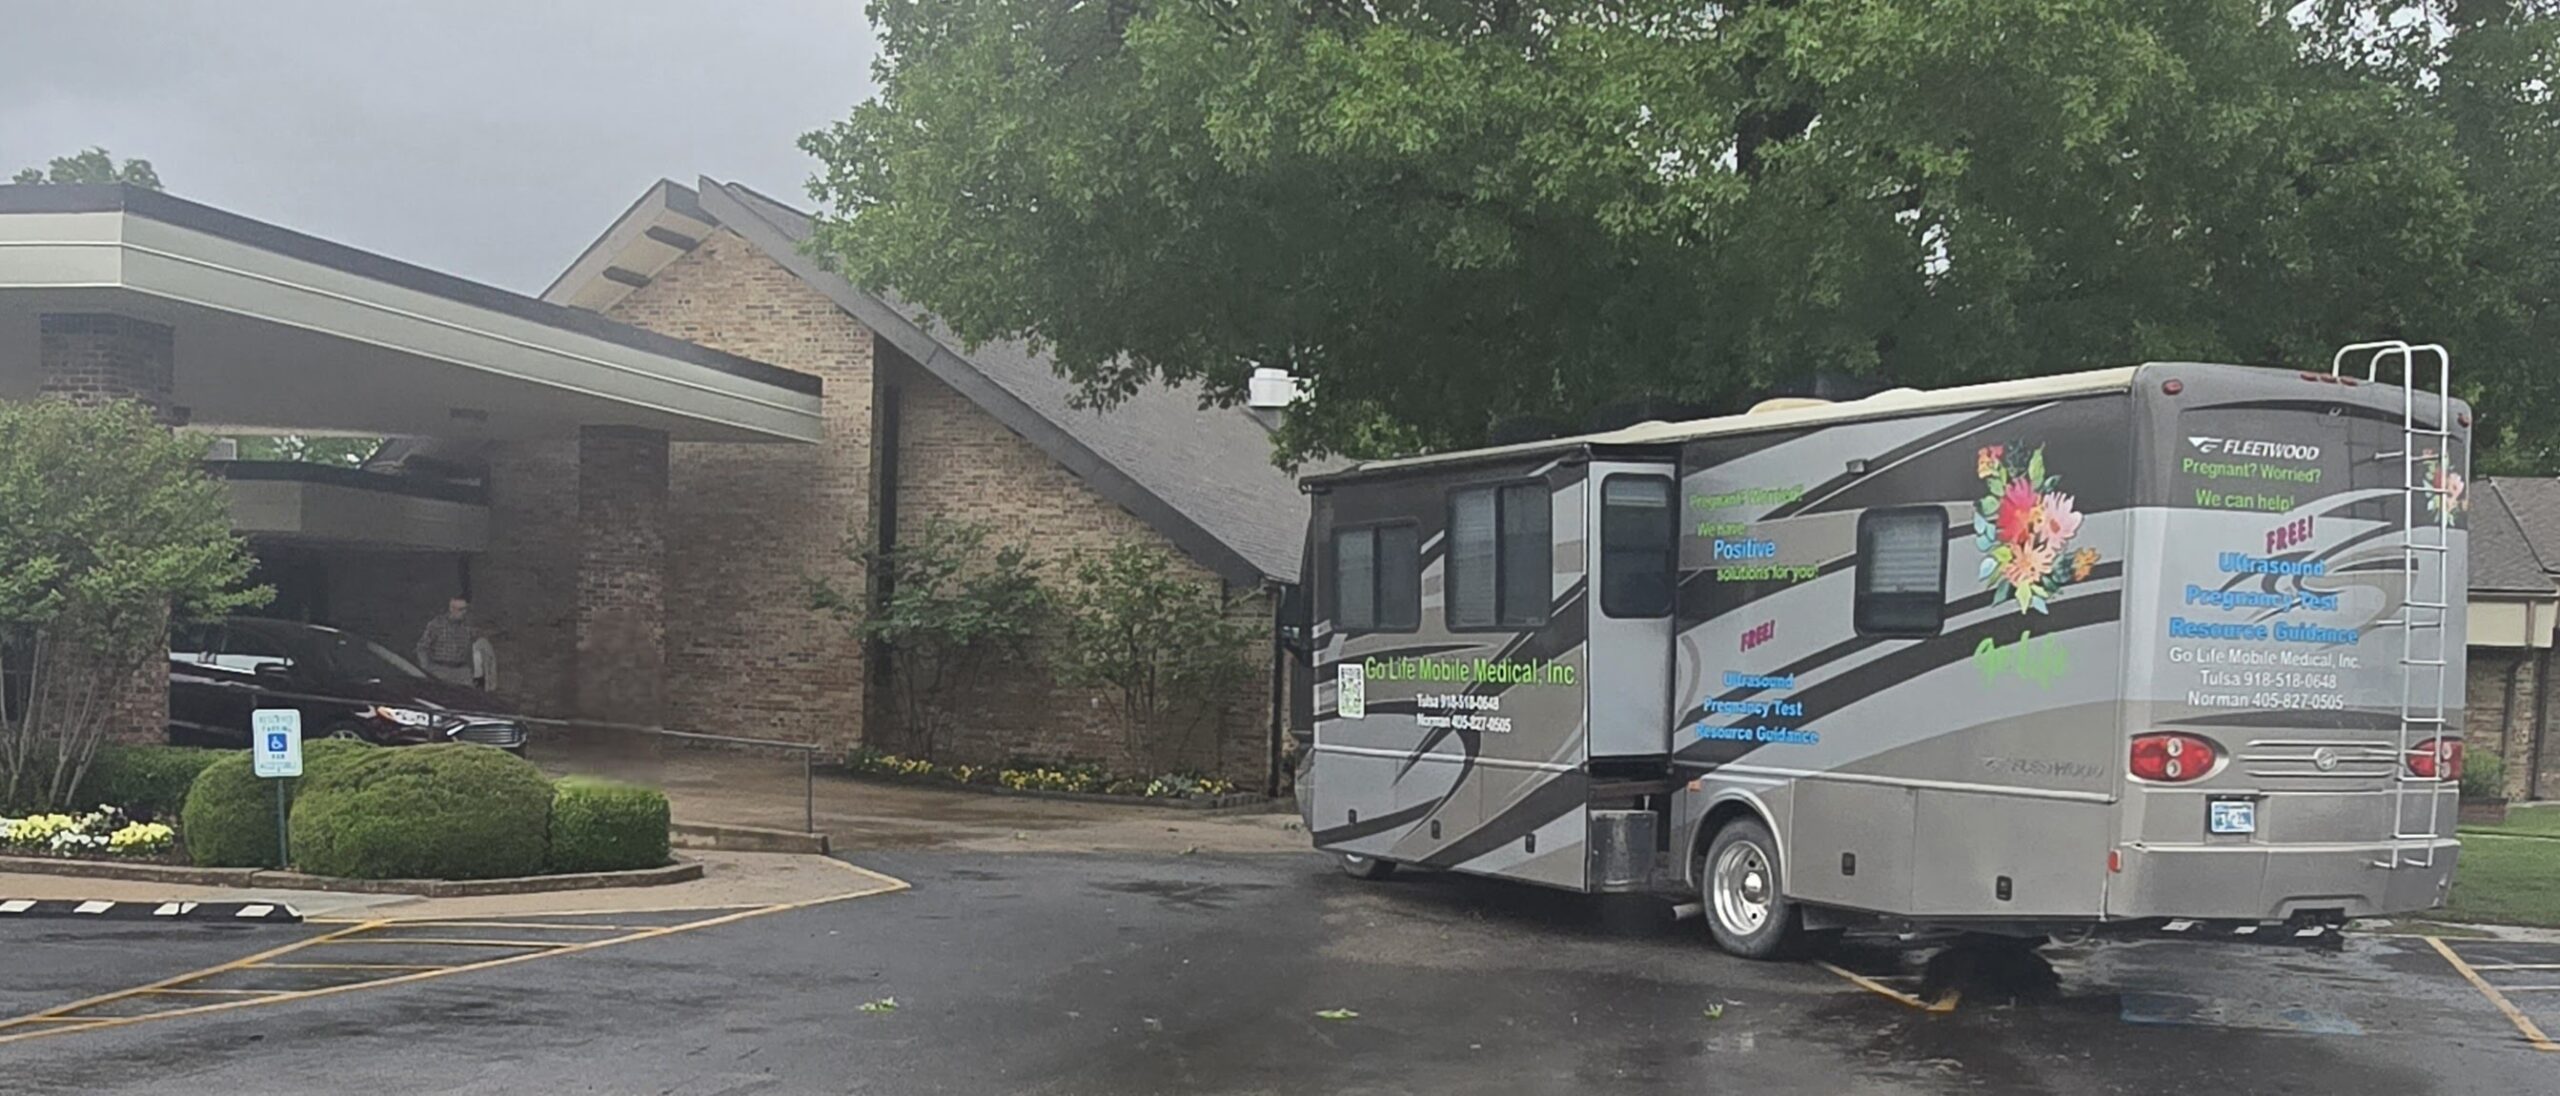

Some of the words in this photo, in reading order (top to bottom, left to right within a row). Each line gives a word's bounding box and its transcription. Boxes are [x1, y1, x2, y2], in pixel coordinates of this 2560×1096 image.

[2223, 438, 2321, 461] FLEETWOOD
[2183, 457, 2257, 479] Pregnant?
[2260, 463, 2322, 484] Worried?
[2196, 488, 2222, 507] We
[2224, 495, 2255, 509] can
[2257, 493, 2296, 514] help!
[2266, 515, 2315, 555] FREE!
[1713, 538, 1776, 560] Positive
[1717, 564, 1769, 582] solutions
[1771, 562, 1788, 579] for
[2219, 552, 2325, 576] Ultrasound
[2185, 584, 2294, 613] Pregnancy
[2298, 591, 2339, 611] Test
[1740, 619, 1776, 653] FREE!
[2168, 616, 2269, 641] Resource
[2273, 621, 2360, 645] Guidance
[2169, 647, 2193, 663] Go
[2196, 648, 2225, 664] Life
[2229, 649, 2278, 665] Mobile
[2280, 651, 2336, 669] Medical,
[2339, 653, 2362, 669] Inc.
[1364, 656, 1386, 679] Go
[1389, 656, 1416, 680] Life
[1419, 657, 1470, 682] Mobile
[1473, 657, 1542, 685] Medical,
[1547, 659, 1578, 685] Inc.
[1723, 671, 1794, 690] Ultrasound
[2200, 669, 2241, 686] Tulsa
[2244, 671, 2337, 689] 918-518-0648
[1416, 693, 1439, 708] Tulsa
[1703, 695, 1770, 718] Pregnancy
[1773, 699, 1803, 717] Test
[2188, 690, 2249, 706] Norman
[2252, 692, 2344, 710] 405-827-0505
[1696, 721, 1753, 740] Resource
[1756, 726, 1819, 745] Guidance
